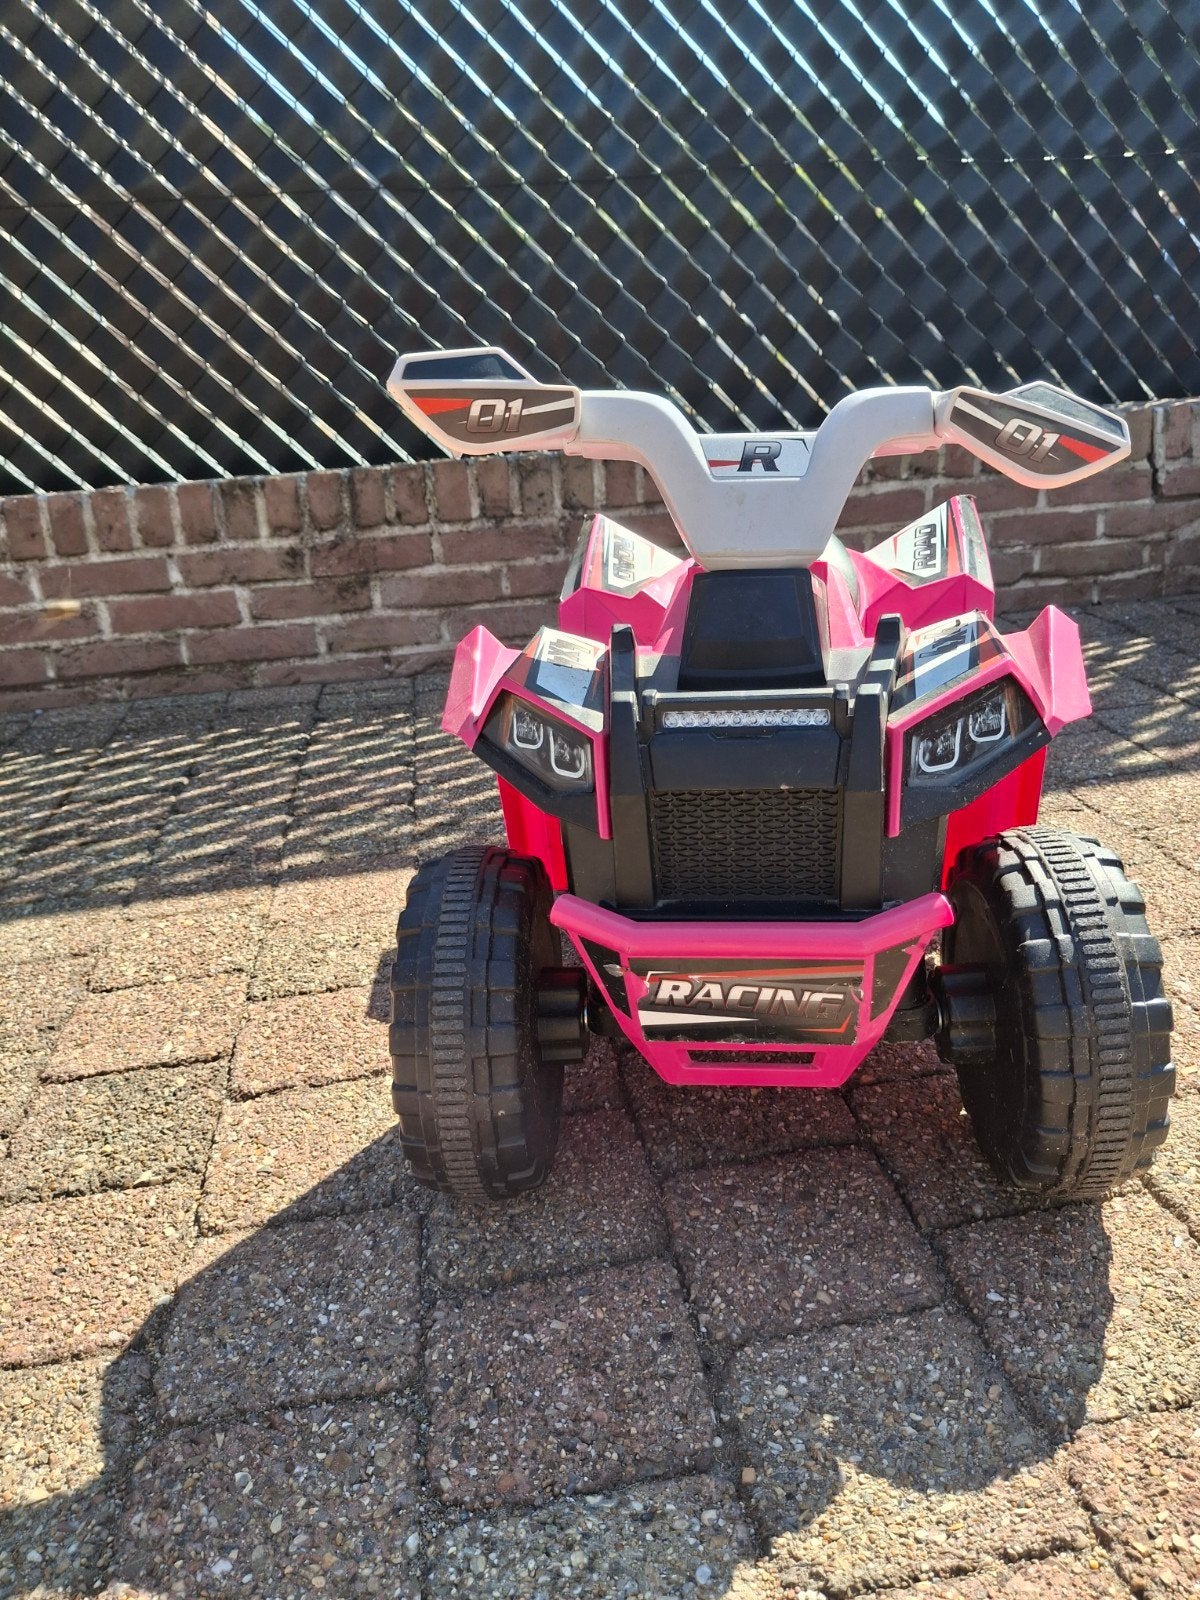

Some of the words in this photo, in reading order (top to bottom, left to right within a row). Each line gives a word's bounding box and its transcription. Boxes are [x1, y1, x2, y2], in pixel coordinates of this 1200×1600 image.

[466, 398, 523, 433] 01
[737, 441, 783, 472] R
[995, 418, 1060, 463] 01
[913, 524, 937, 571] ROAD
[654, 979, 844, 1021] RACING
